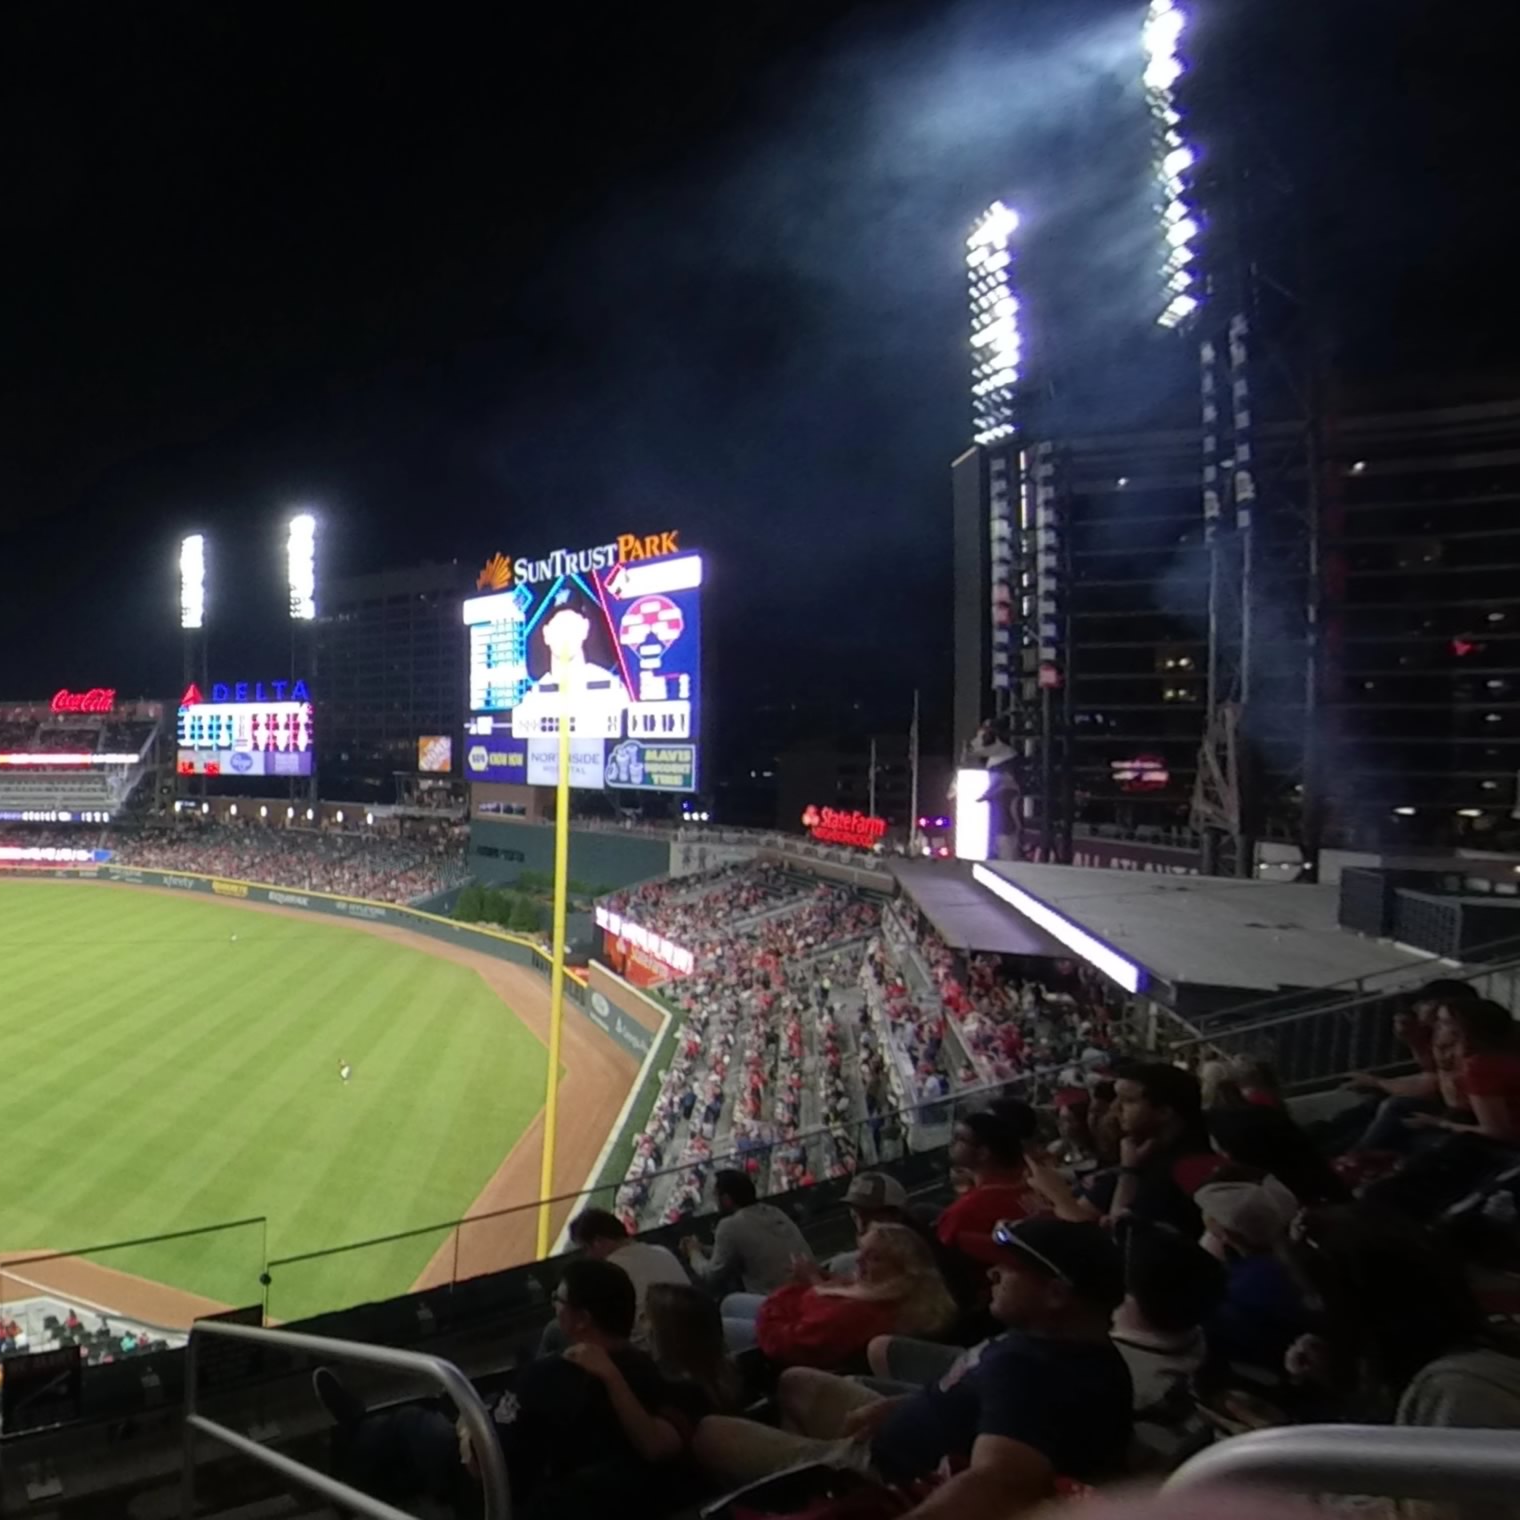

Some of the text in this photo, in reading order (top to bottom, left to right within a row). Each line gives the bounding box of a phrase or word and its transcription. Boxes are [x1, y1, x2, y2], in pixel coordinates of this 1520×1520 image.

[617, 530, 679, 564] PARK
[212, 679, 310, 702] DELTA
[531, 751, 600, 765] NORSIDE
